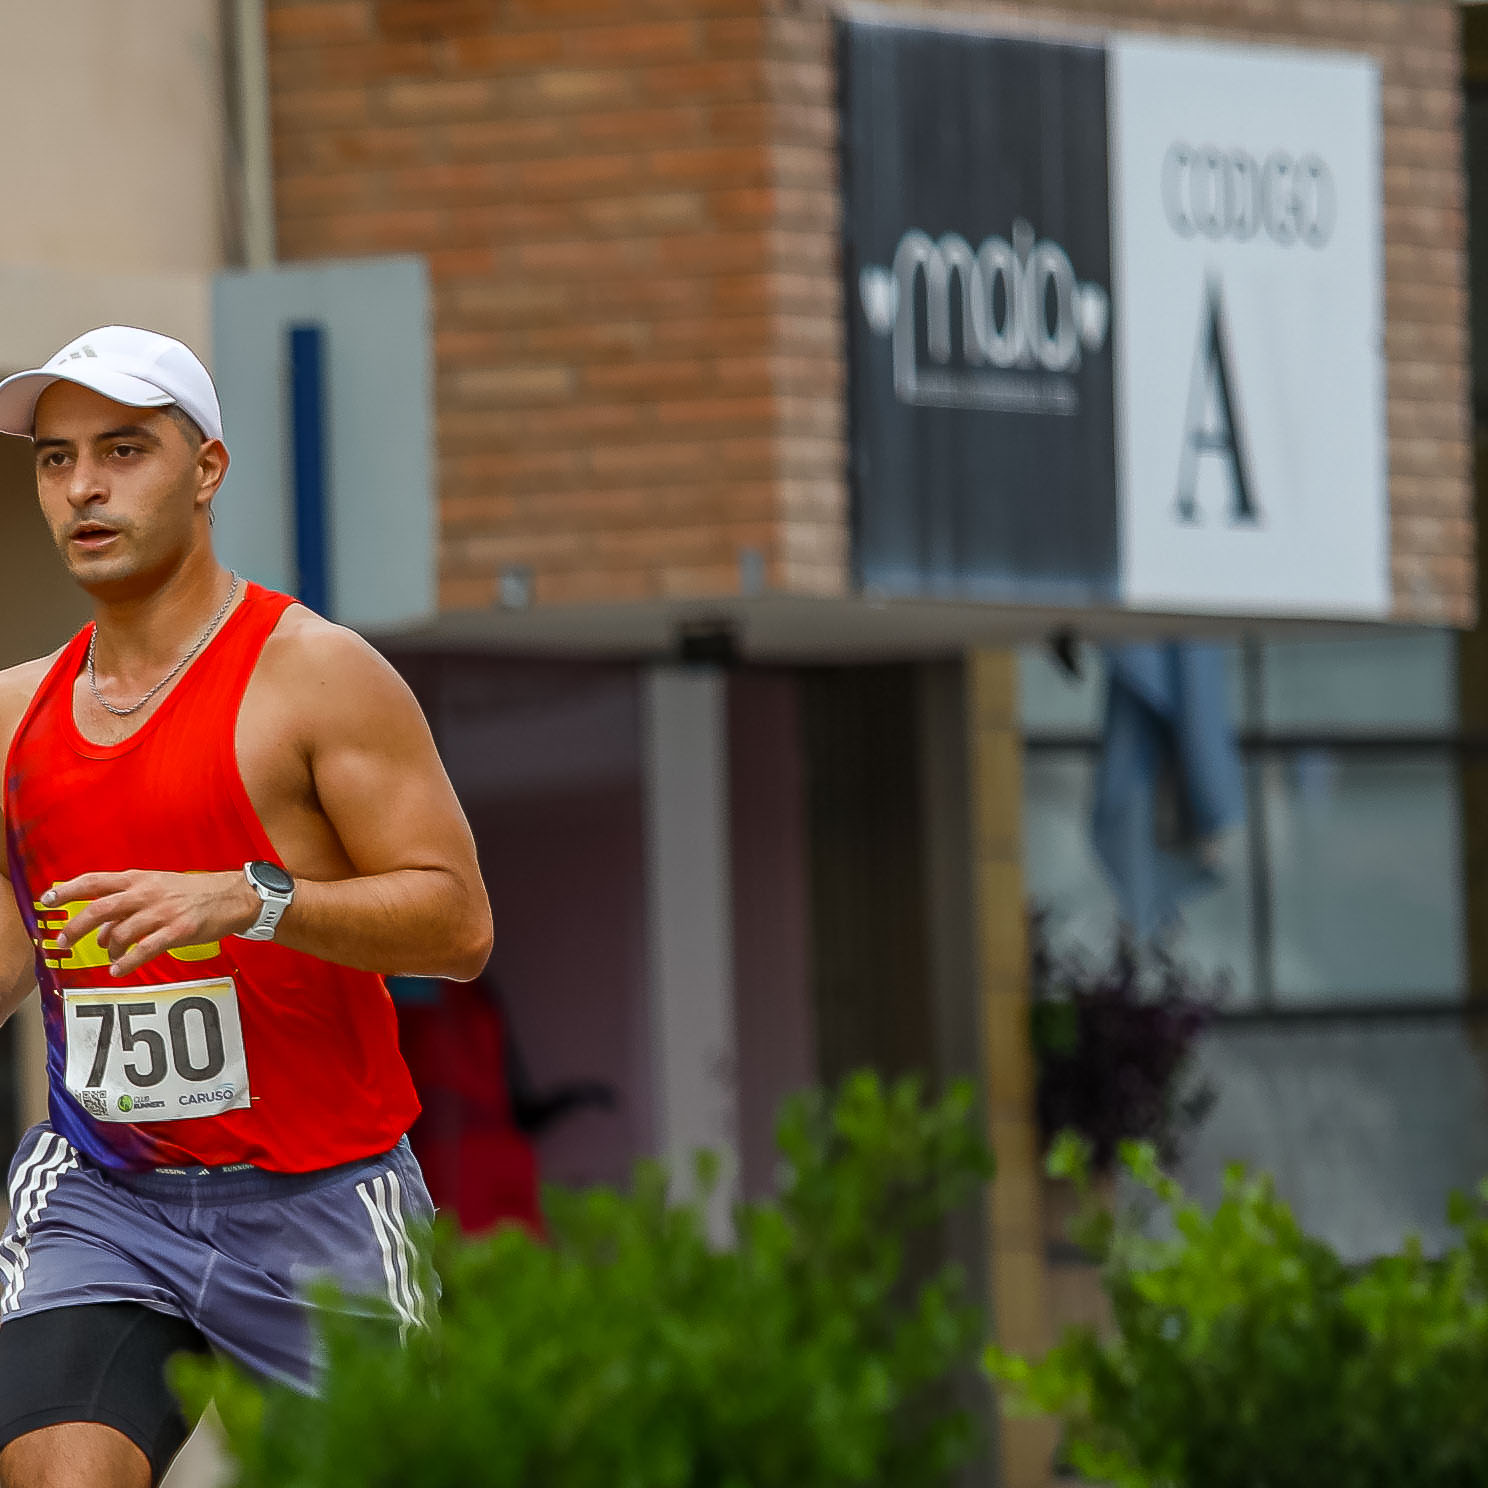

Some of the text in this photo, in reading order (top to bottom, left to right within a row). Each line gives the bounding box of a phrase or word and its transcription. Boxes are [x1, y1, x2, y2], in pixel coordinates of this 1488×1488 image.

[1174, 262, 1264, 530] A
[75, 996, 225, 1088] 750
[178, 1089, 234, 1106] CARUSO
